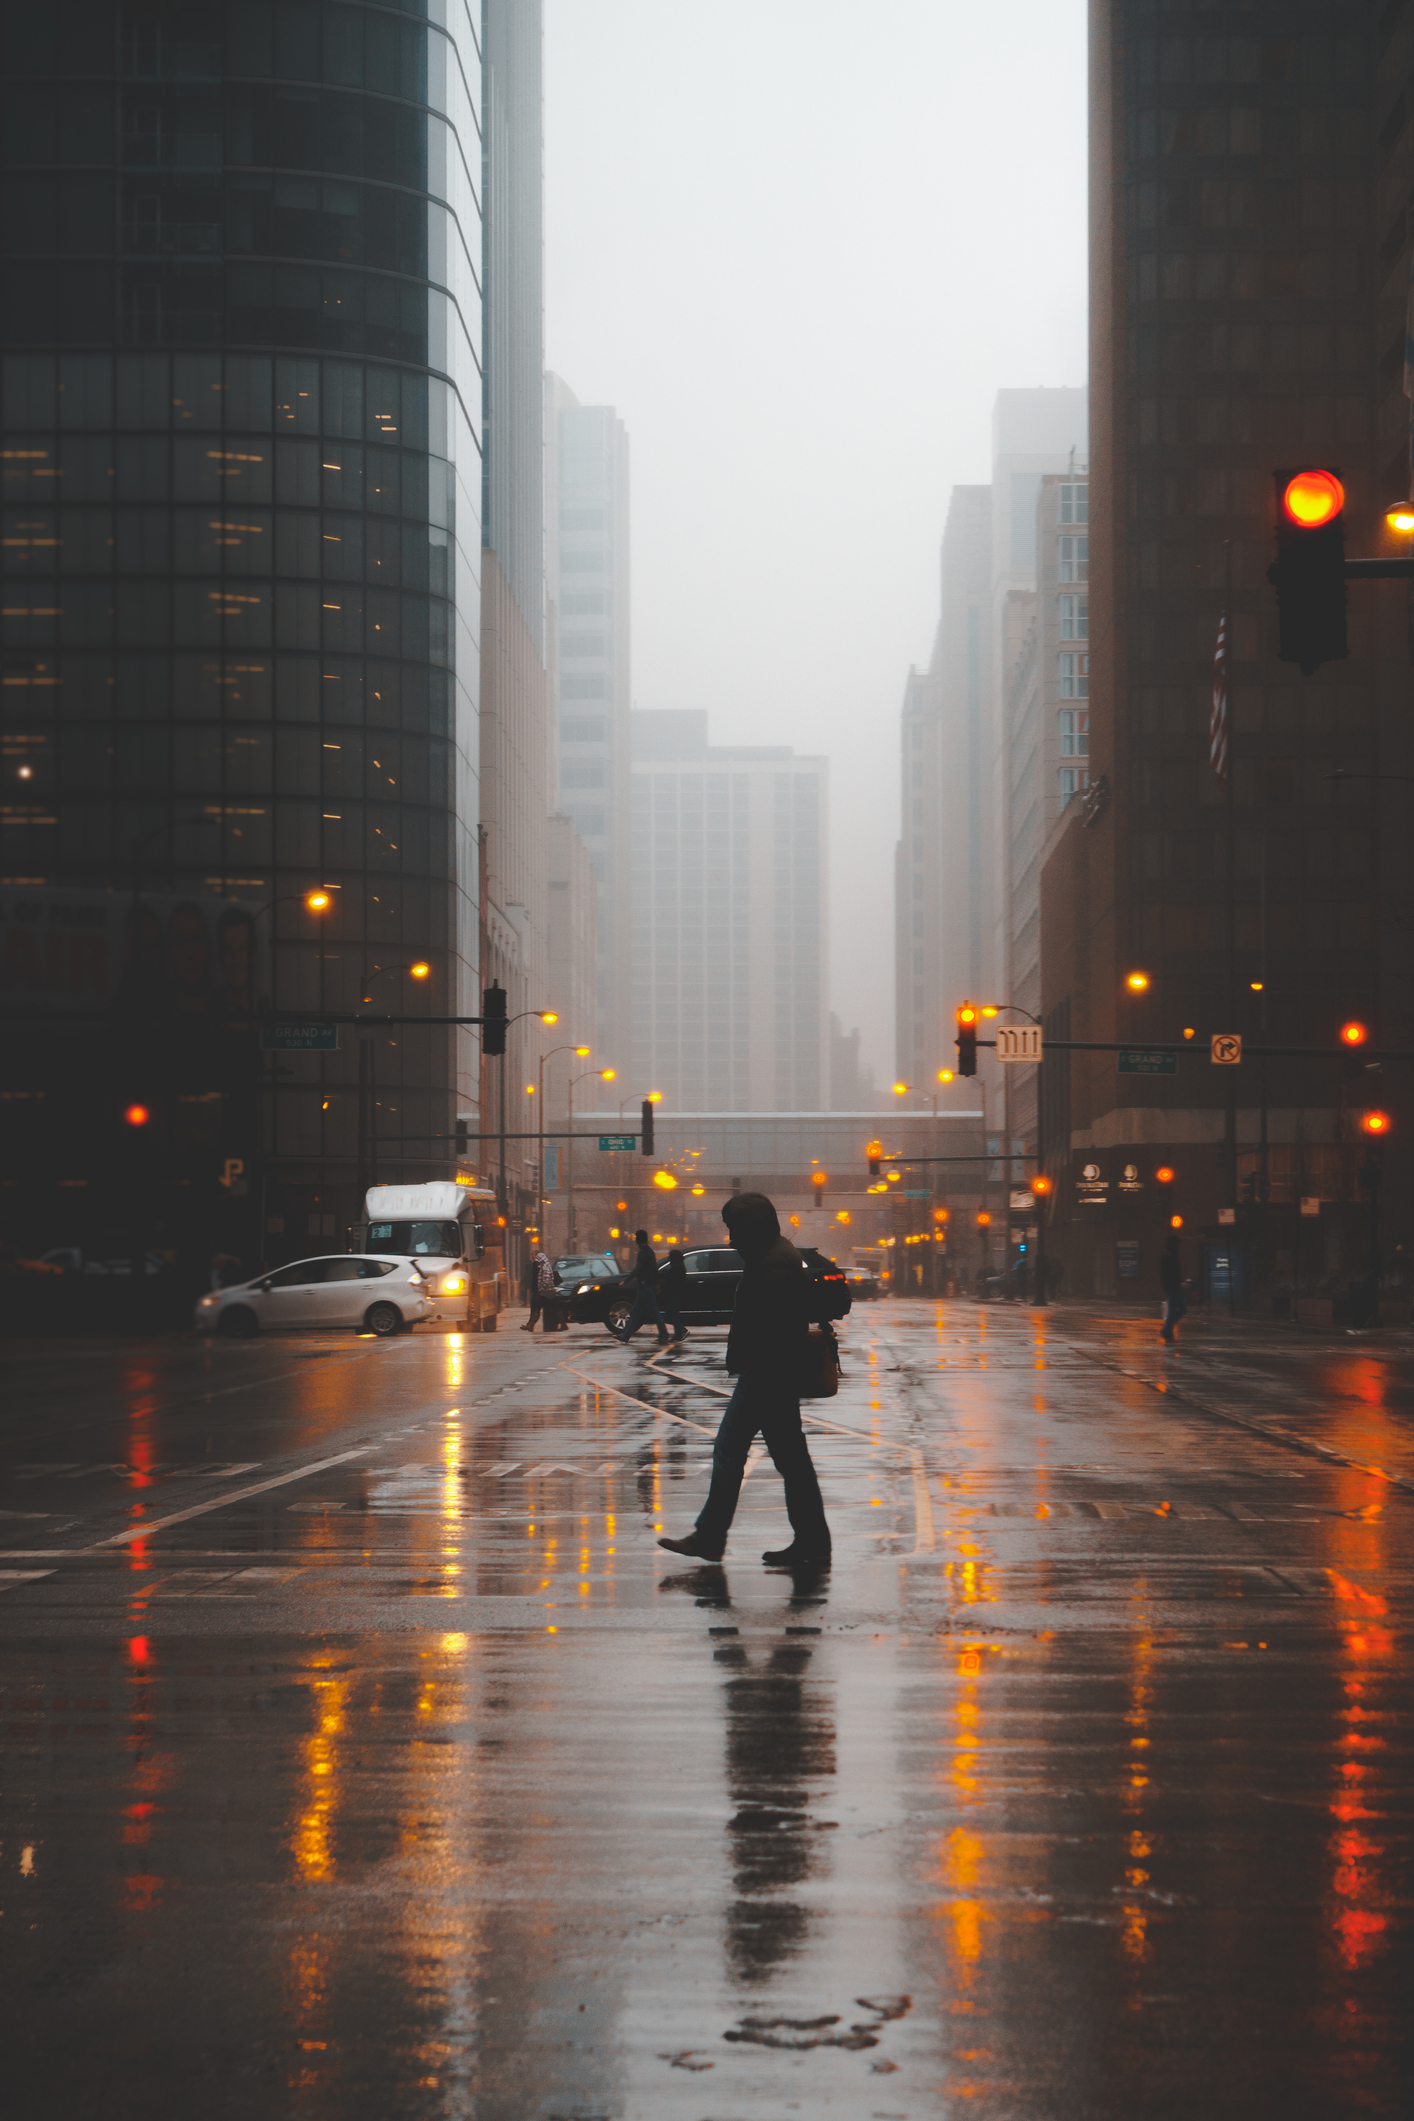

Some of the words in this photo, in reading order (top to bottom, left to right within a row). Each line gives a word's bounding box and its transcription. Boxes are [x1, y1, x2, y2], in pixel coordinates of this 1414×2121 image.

[275, 1027, 318, 1038] GRAND
[286, 1039, 303, 1047] 530
[306, 1039, 313, 1047] N
[1128, 1054, 1164, 1064] GRAND
